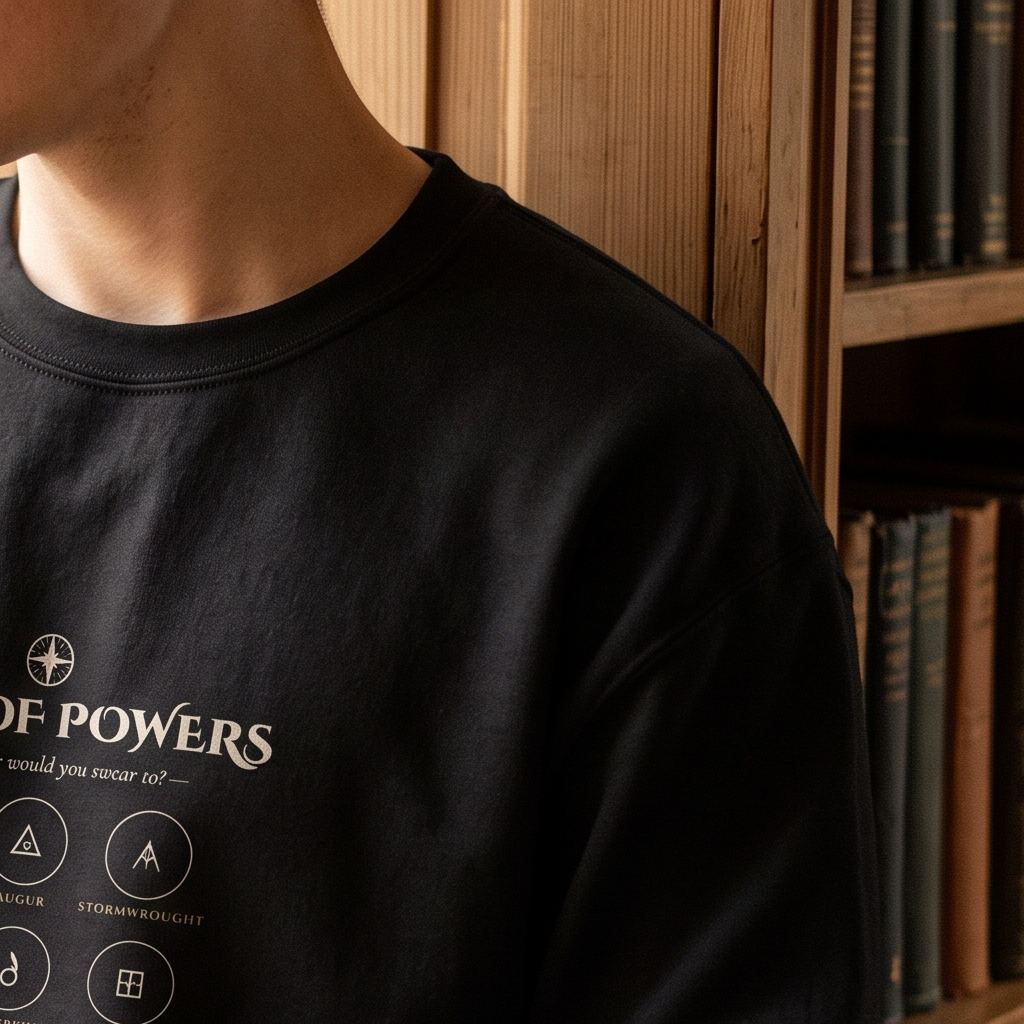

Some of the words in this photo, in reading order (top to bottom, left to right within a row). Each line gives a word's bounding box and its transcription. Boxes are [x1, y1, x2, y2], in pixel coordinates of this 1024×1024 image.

[55, 702, 274, 770] POWERS
[8, 755, 56, 773] would
[55, 764, 87, 780] you
[91, 768, 138, 781] swear
[142, 770, 167, 785] to?
[78, 902, 204, 926] STORMWROUGHT
